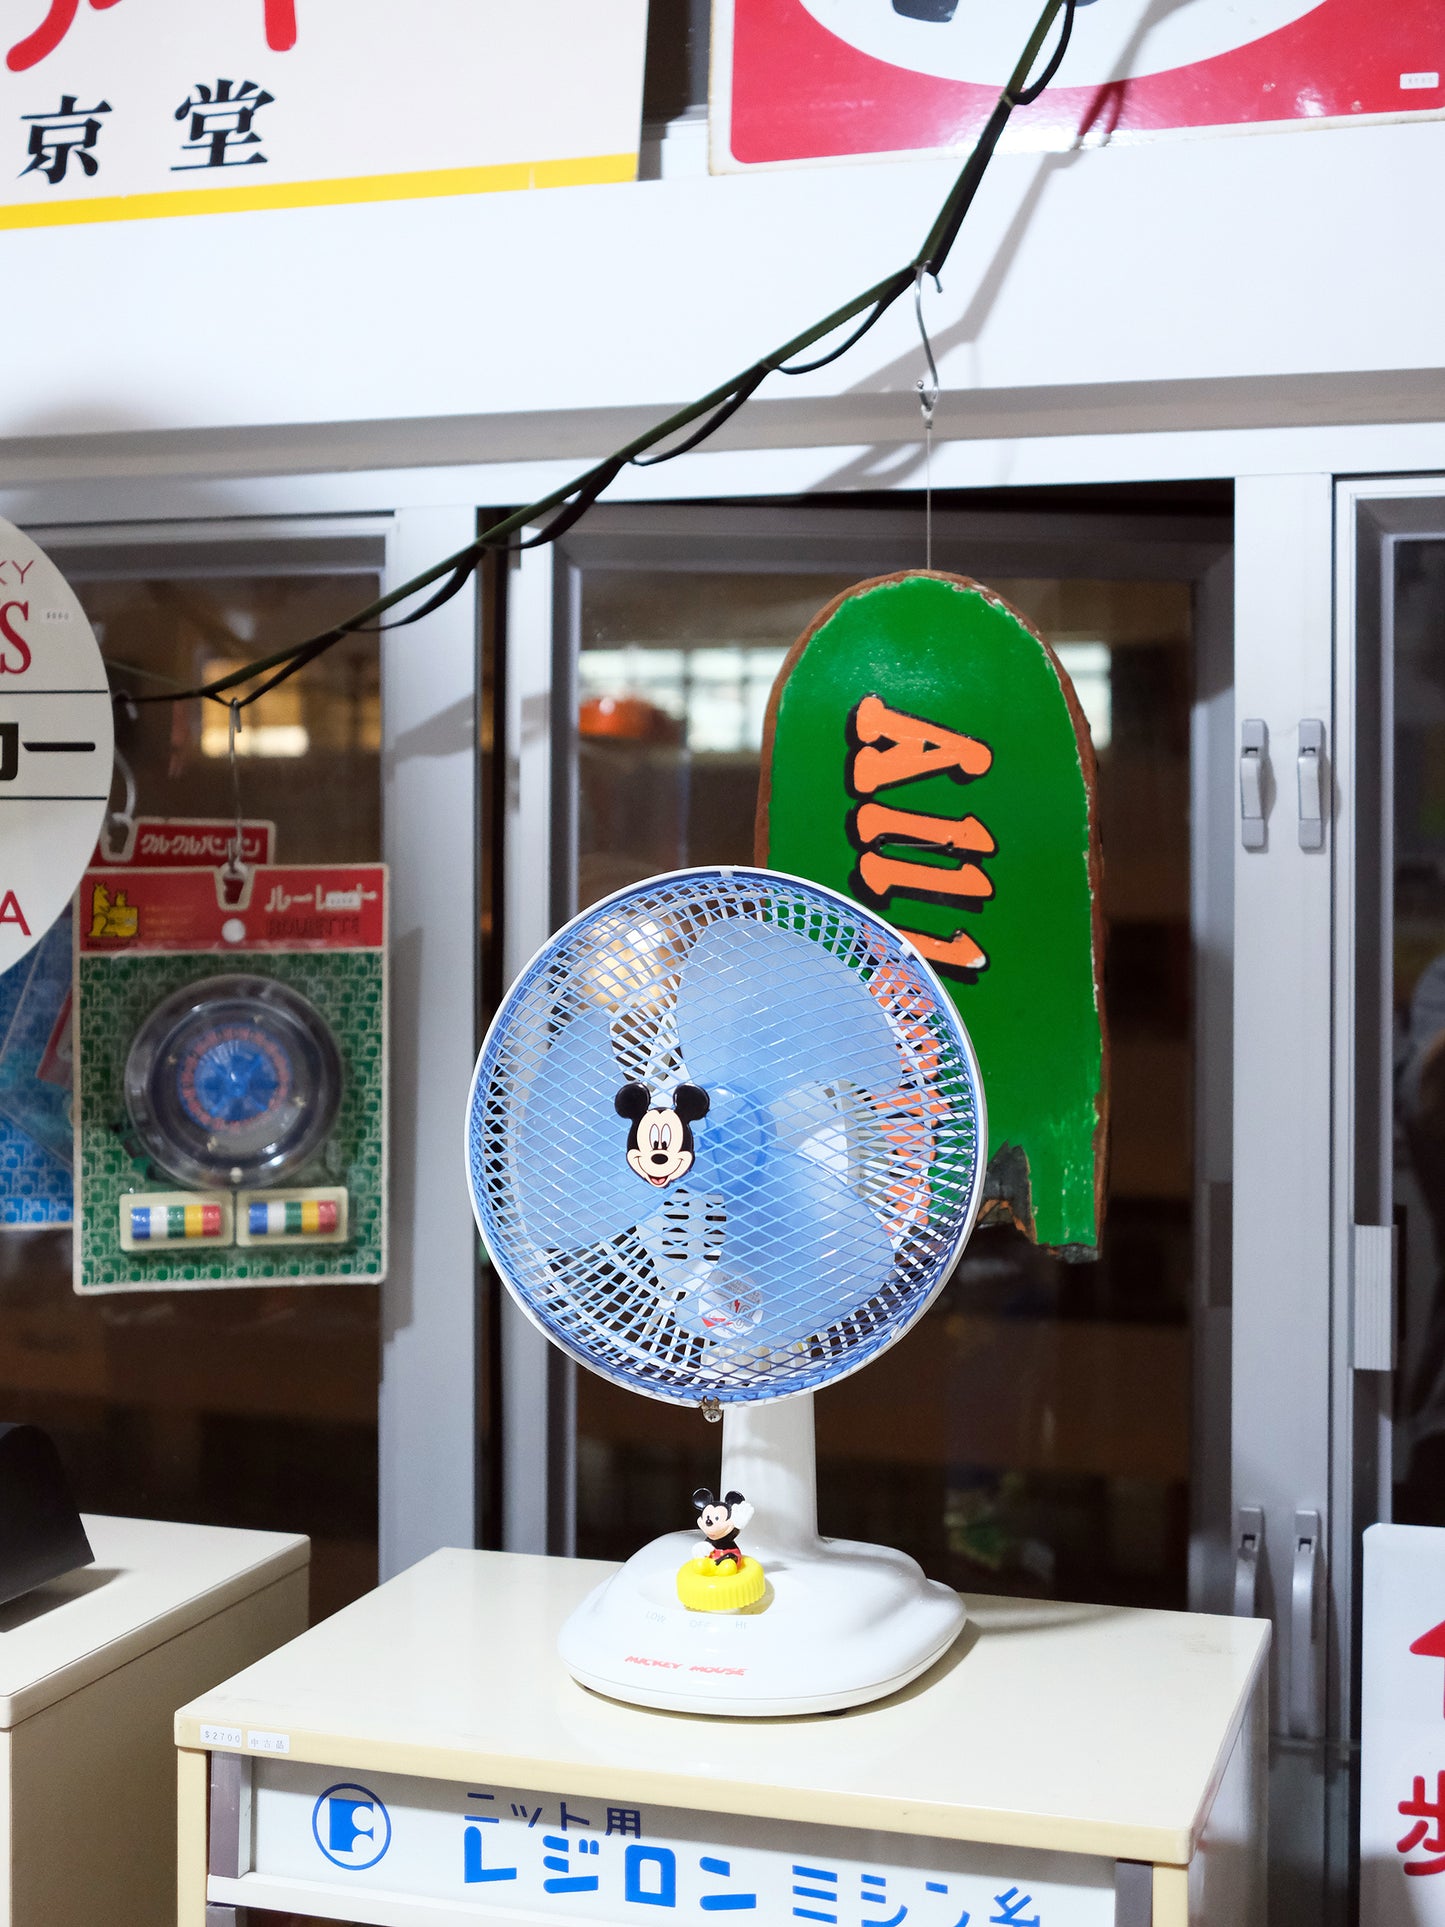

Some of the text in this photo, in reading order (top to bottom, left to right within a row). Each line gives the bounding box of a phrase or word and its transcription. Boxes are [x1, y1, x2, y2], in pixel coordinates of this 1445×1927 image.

[0, 560, 34, 585] Y
[624, 1655, 748, 1676] MICKEY MOUSE
[463, 1792, 641, 1840] ニット用
